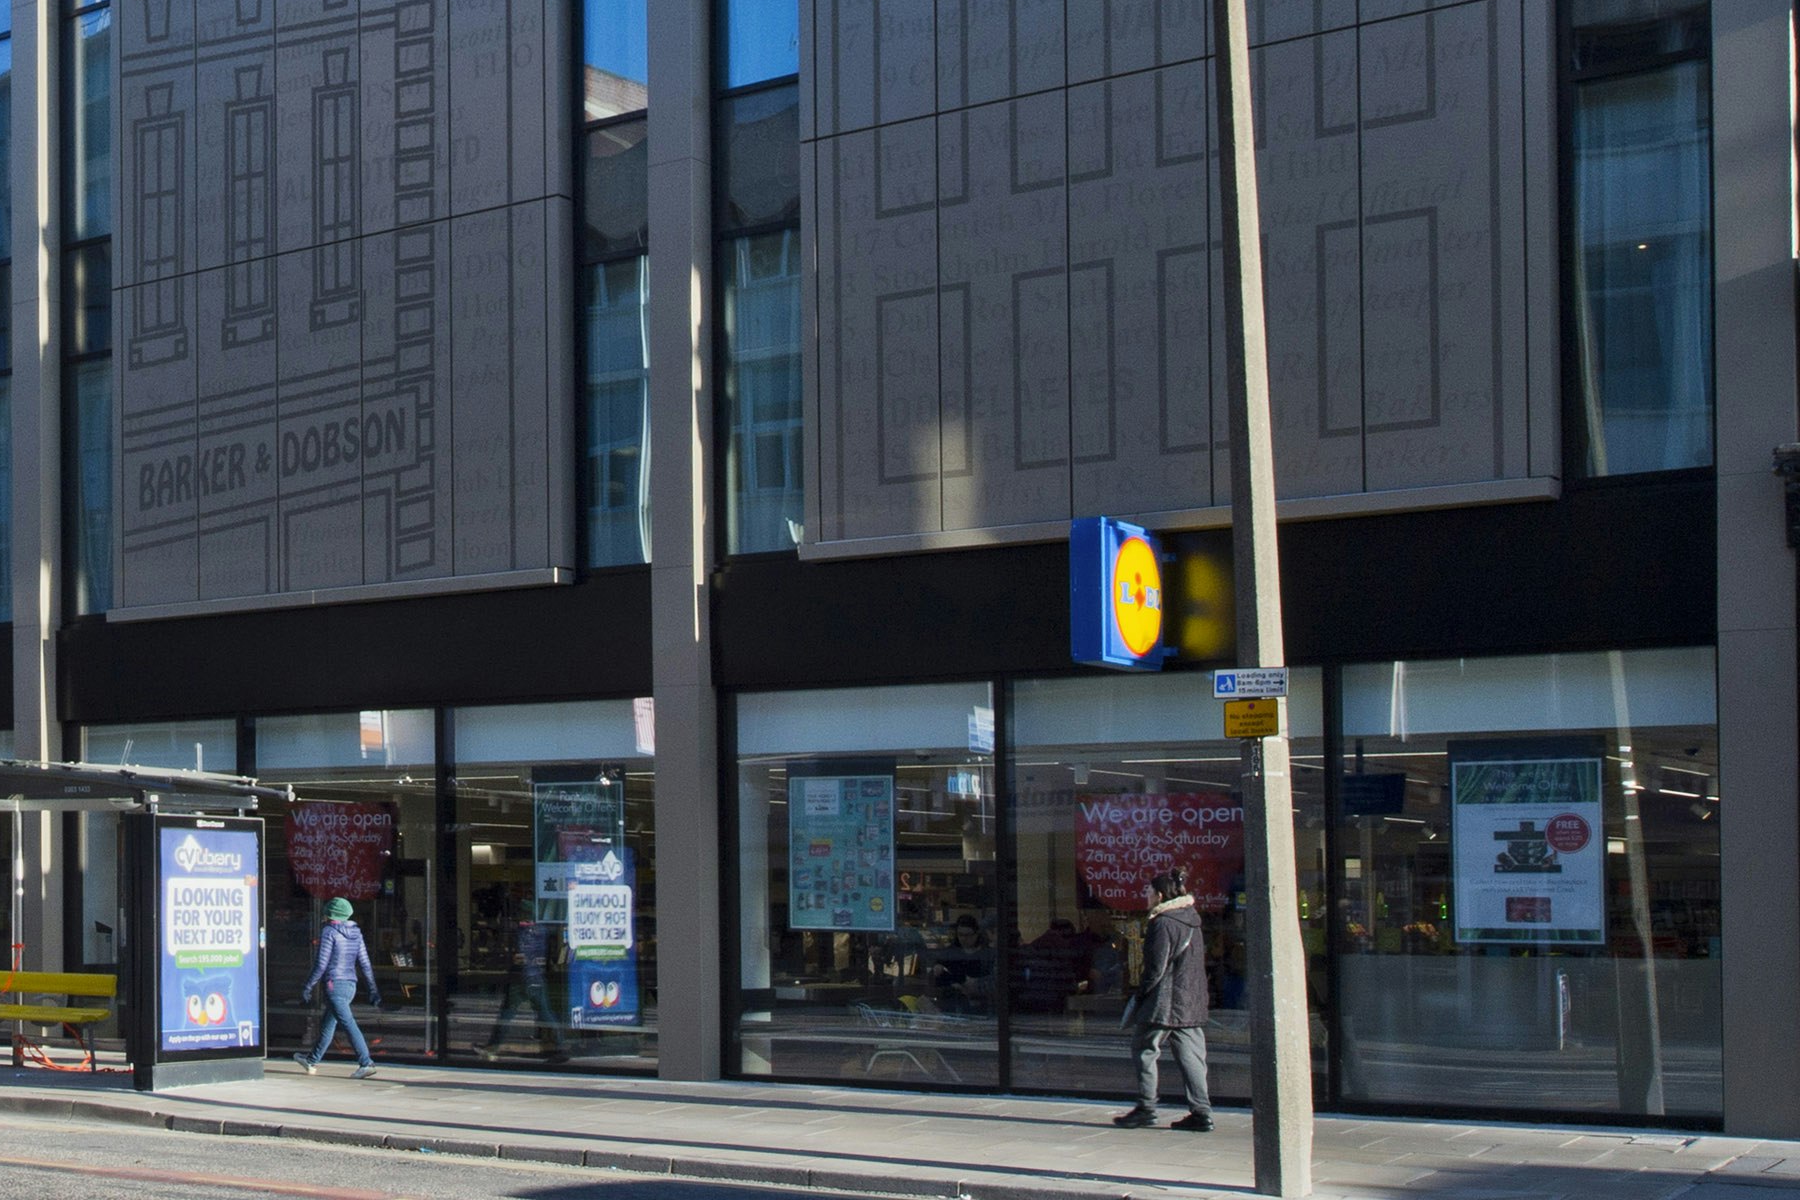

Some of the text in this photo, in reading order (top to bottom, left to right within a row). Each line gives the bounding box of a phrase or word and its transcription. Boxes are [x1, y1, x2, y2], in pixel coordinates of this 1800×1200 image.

[139, 441, 247, 512] BARKER
[255, 441, 272, 474] &
[282, 405, 406, 478] DOBSON
[291, 809, 392, 829] We are open
[1080, 802, 1244, 829] We are open
[1555, 820, 1580, 830] FREE
[1085, 832, 1143, 846] Monday
[1165, 830, 1229, 848] Saturday
[1086, 866, 1137, 882] Sunday
[173, 887, 244, 907] LOOKING
[1087, 884, 1126, 898] 11am
[173, 909, 243, 926] FOR YOUR
[173, 928, 243, 945] NEXT JOB?
[178, 954, 198, 964] Search
